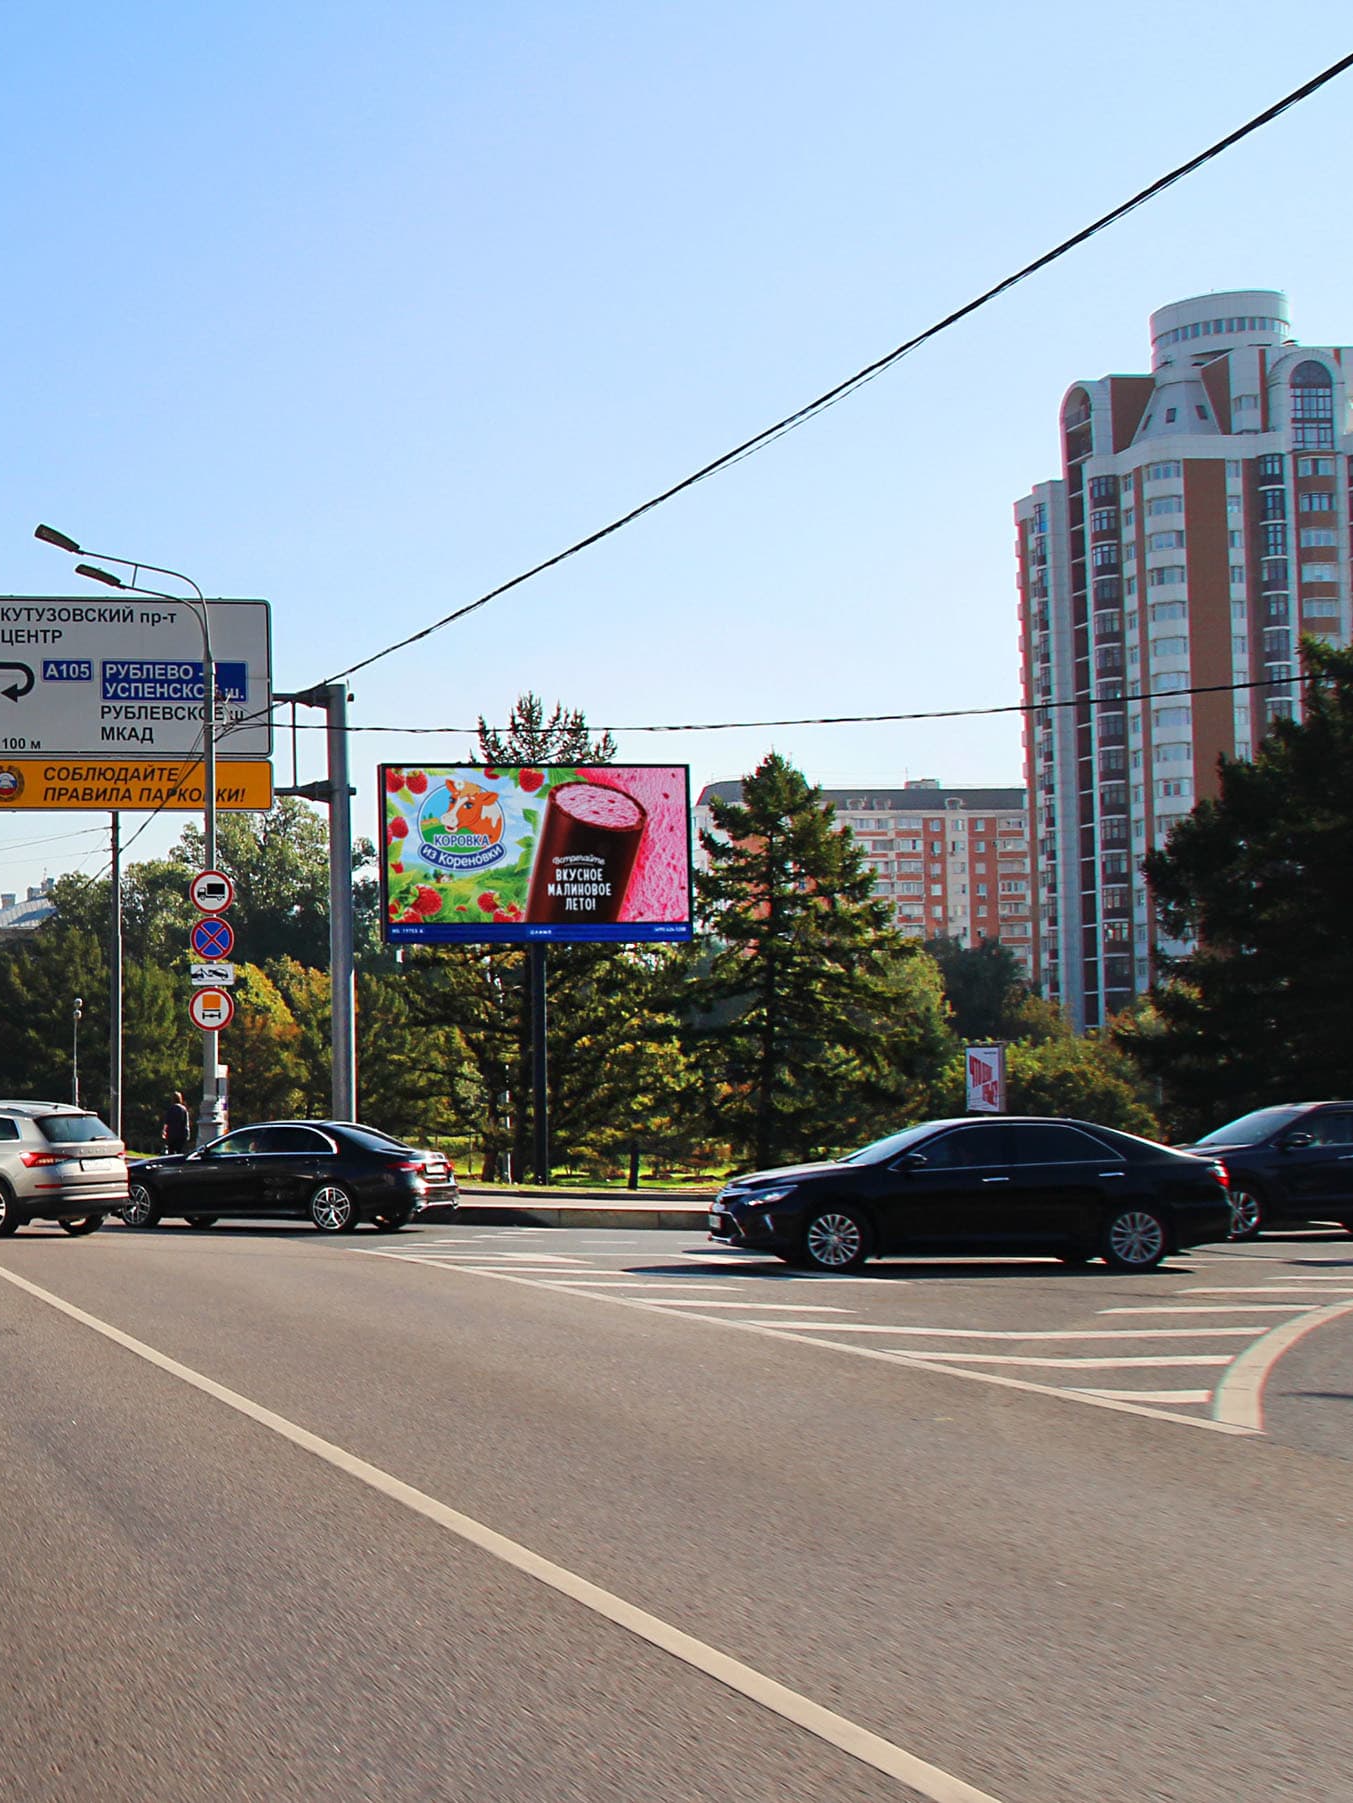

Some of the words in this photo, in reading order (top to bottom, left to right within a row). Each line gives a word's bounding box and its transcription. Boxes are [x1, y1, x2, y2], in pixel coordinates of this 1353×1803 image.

[1, 606, 134, 623] КУТУЗОВСКИЙ
[140, 612, 177, 627] пр-т
[1, 629, 63, 646] ЦЕНТР
[46, 664, 89, 678] А105
[105, 664, 194, 680] РУБЛЕВО
[105, 682, 215, 699] УСПЕНСКО
[101, 727, 154, 744] МКАД
[2, 737, 26, 750] 100
[30, 740, 41, 750] м
[44, 766, 179, 785] СОБЛЮДАЙТЕ
[44, 788, 133, 802] ПРАВИЛА
[139, 788, 246, 802] ПАРКОКИ!
[434, 834, 490, 847] КОРОВКА
[555, 868, 603, 881] ВКУСНОЕ
[547, 883, 612, 896] МАЛИНОВОЕ
[565, 898, 596, 911] ЛЕТО!
